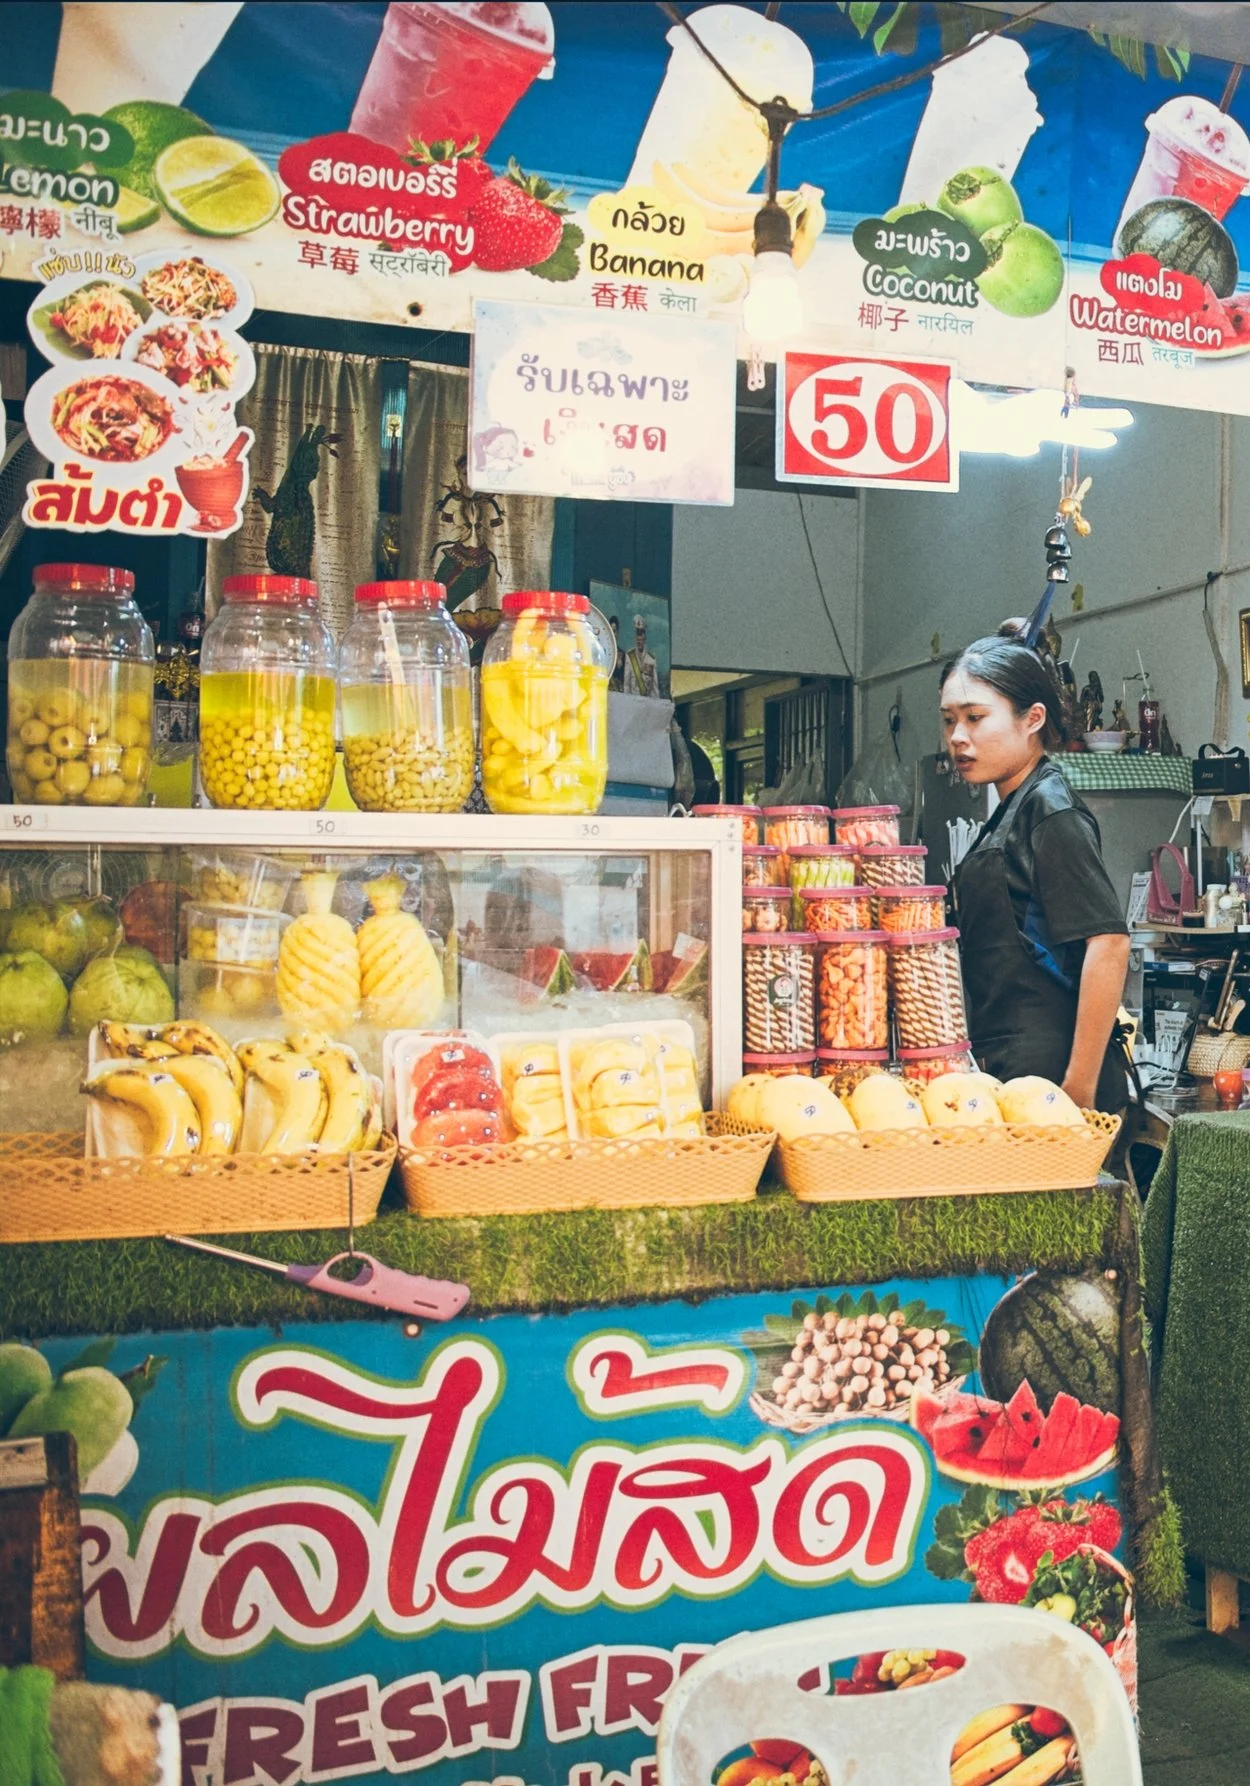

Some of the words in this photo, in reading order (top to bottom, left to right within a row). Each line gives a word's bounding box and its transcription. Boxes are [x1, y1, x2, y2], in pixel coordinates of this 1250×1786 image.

[0, 114, 111, 152] มะนาว
[287, 196, 475, 255] Strawberry
[611, 202, 686, 236] กล้วย
[298, 240, 360, 275] 草莓
[590, 242, 704, 282] Banana
[874, 228, 970, 262] มะพร้าว
[591, 282, 648, 311] 香蕉
[866, 264, 977, 305] Coconut
[1116, 268, 1182, 301] แตงโม
[858, 302, 909, 332] 椰子
[1072, 297, 1222, 346] Watermelon
[1097, 338, 1144, 366] 西瓜
[516, 352, 690, 402] รับเฉพาะ
[809, 376, 934, 461] 50
[32, 463, 182, 529] ส้มตำ
[13, 814, 33, 828] 50
[316, 819, 336, 834] 50
[581, 823, 600, 836] 30
[82, 1350, 911, 1640] ผลไม้สด
[178, 1676, 523, 1786] FRESH
